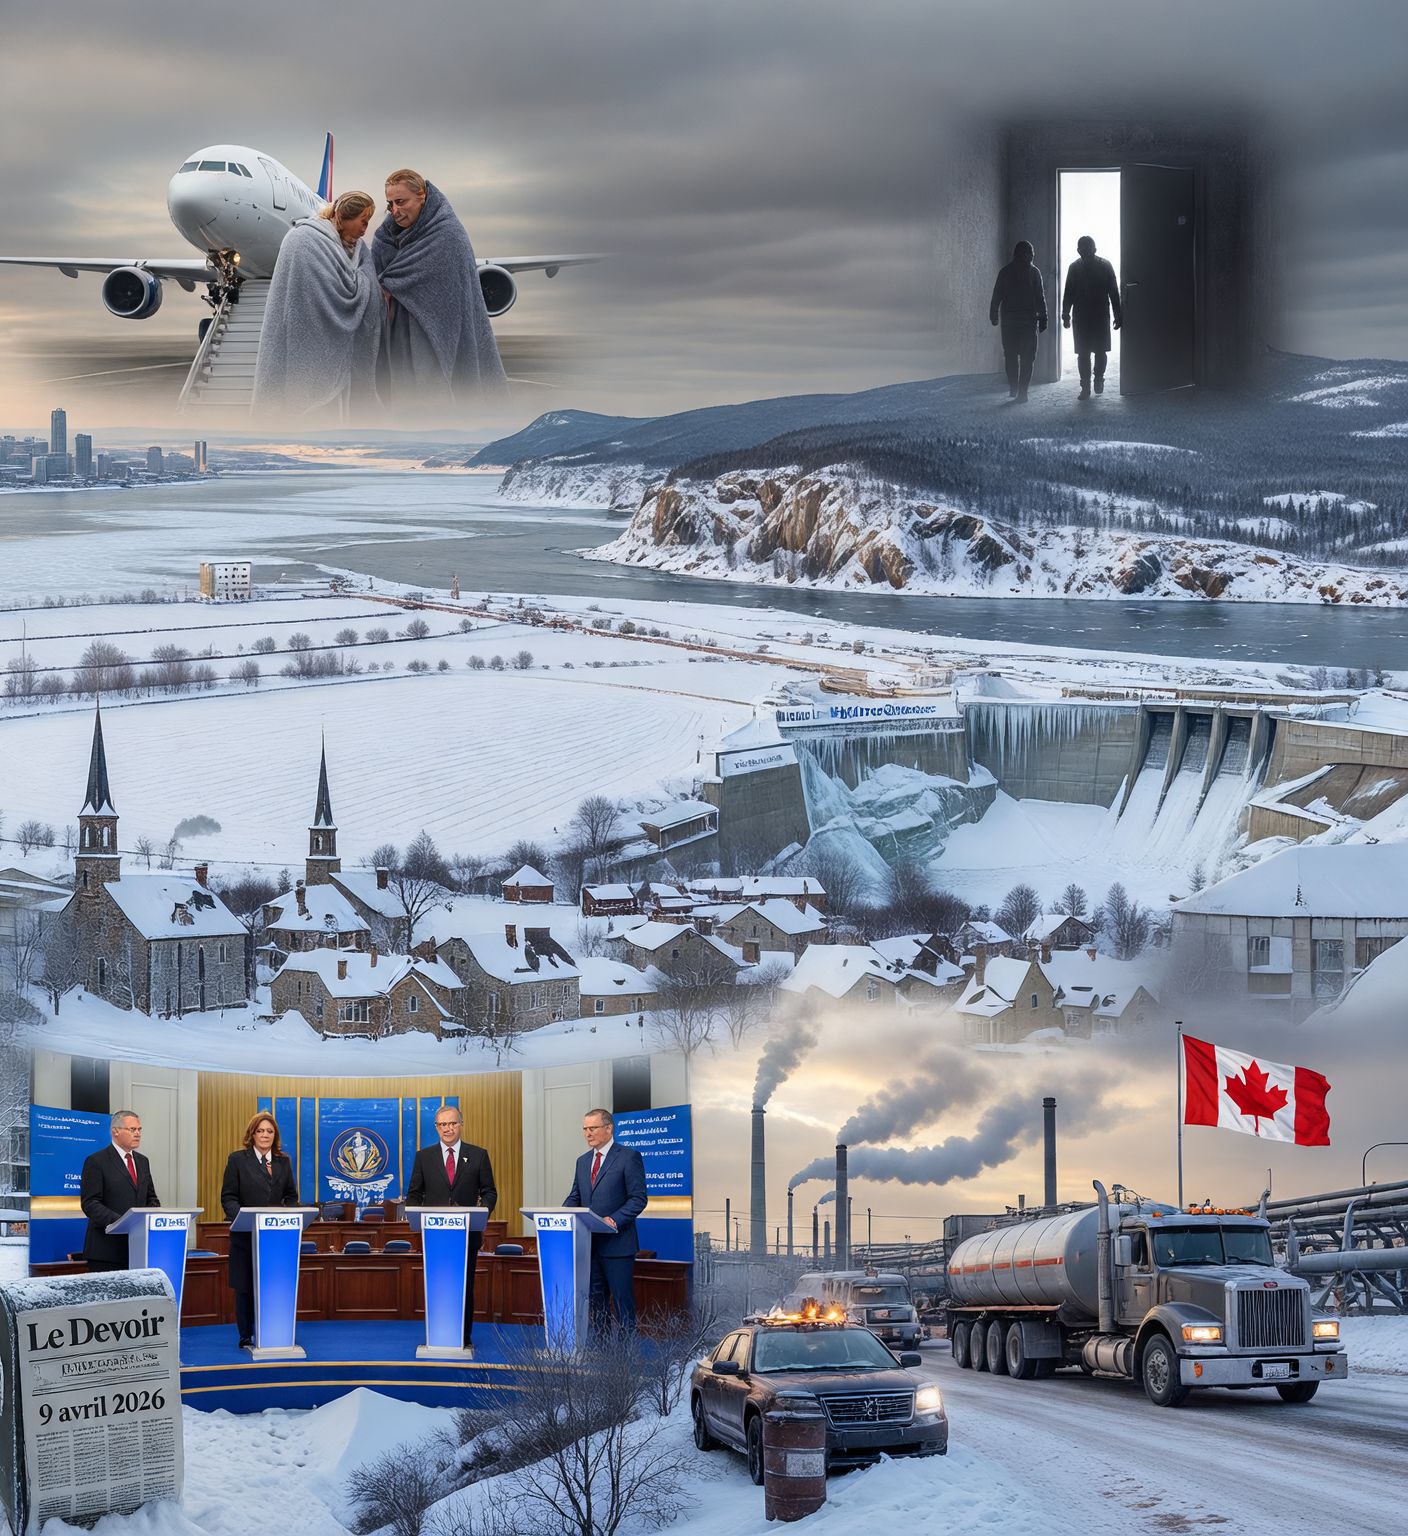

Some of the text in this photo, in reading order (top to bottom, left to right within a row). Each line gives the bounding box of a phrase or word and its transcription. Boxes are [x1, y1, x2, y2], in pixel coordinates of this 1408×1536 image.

[27, 1308, 165, 1352] Le Devoir
[39, 1387, 166, 1426] 9 avril 2026
